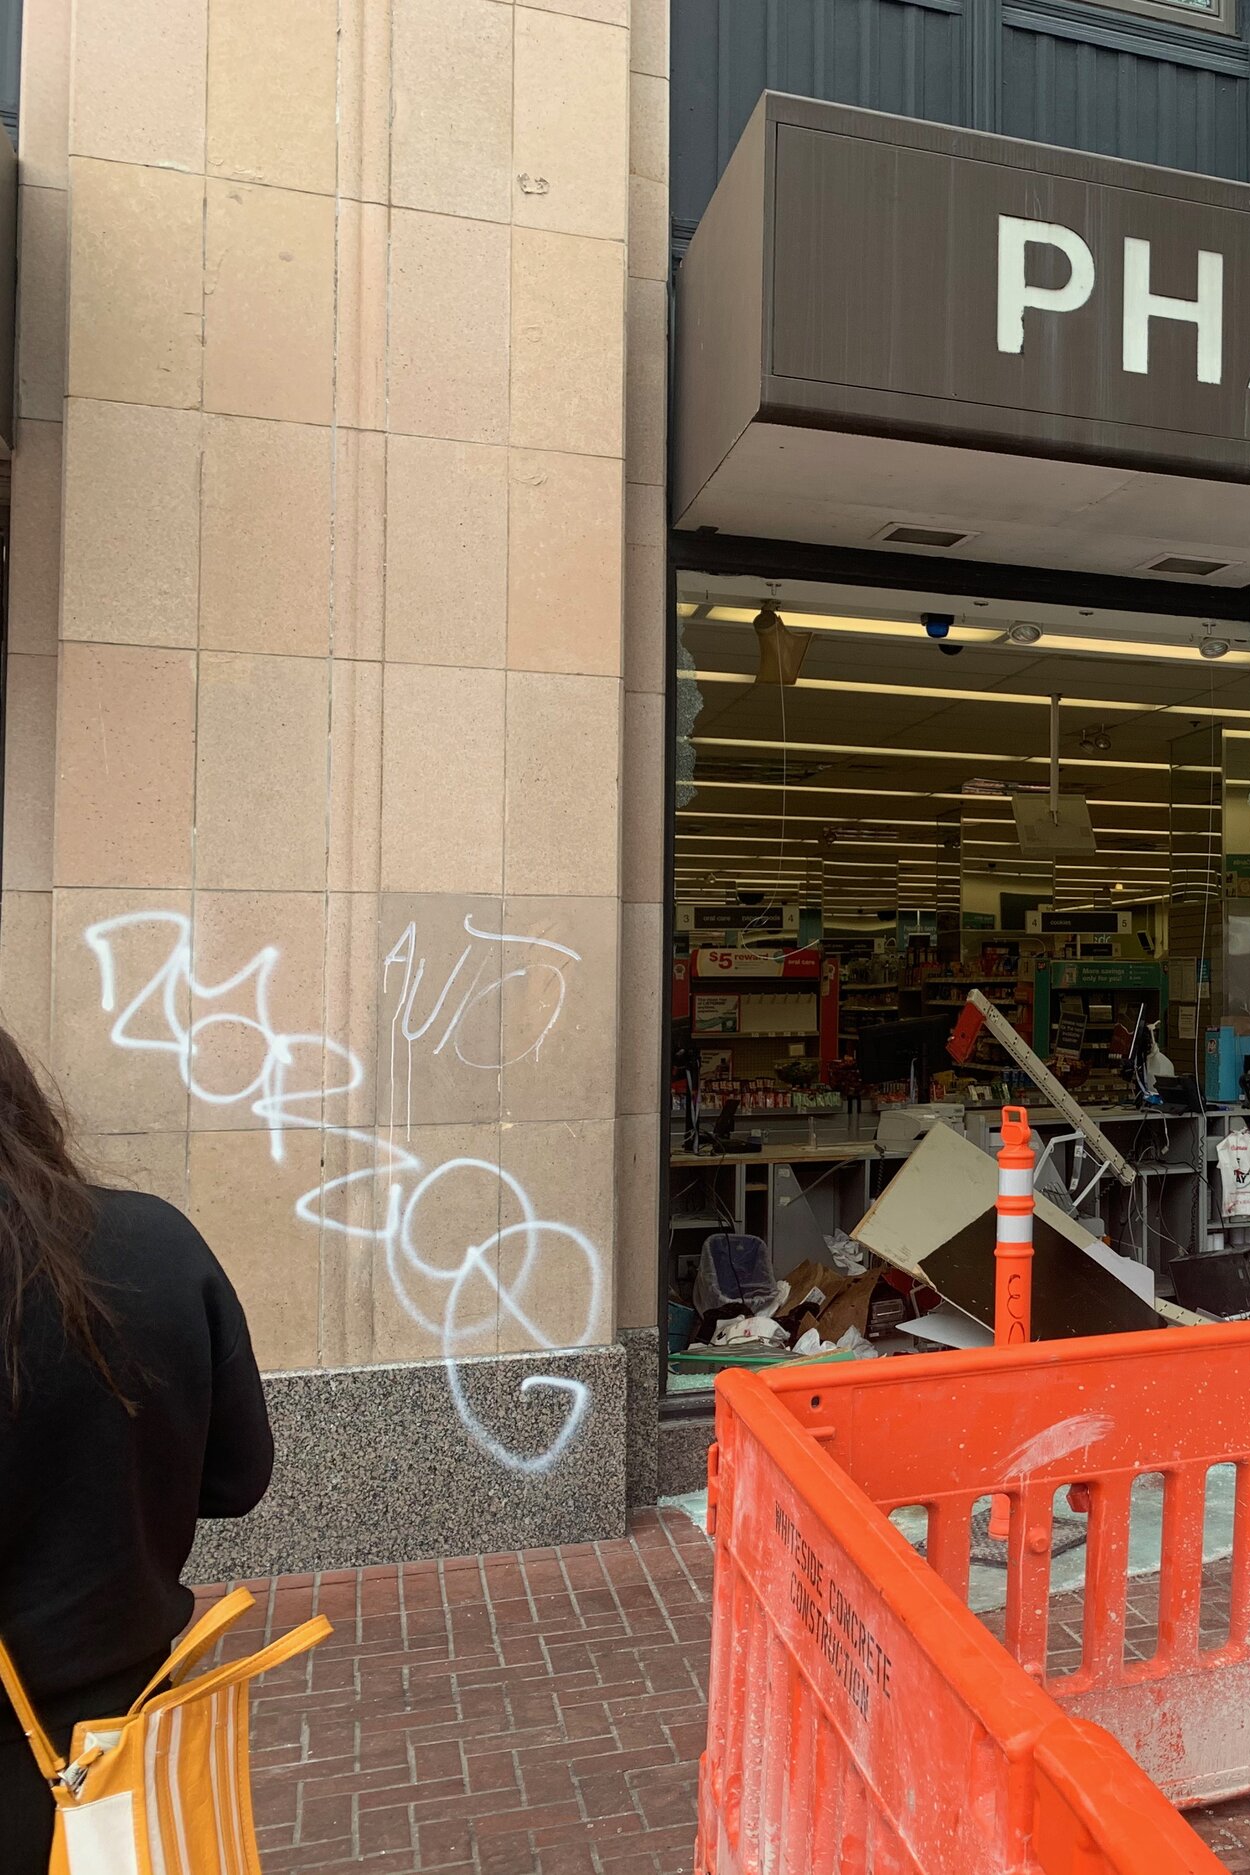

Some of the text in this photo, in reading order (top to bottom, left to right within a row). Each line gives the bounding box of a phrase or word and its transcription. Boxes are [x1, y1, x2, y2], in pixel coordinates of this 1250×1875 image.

[682, 914, 690, 923] 3
[788, 914, 794, 922] 4
[1031, 919, 1038, 928] 4
[1122, 919, 1128, 928] 5
[709, 951, 769, 969] $5 reward
[775, 1499, 892, 1699] WHITESIDE CONCRETE
[789, 1570, 870, 1723] CONSTRUCTION
